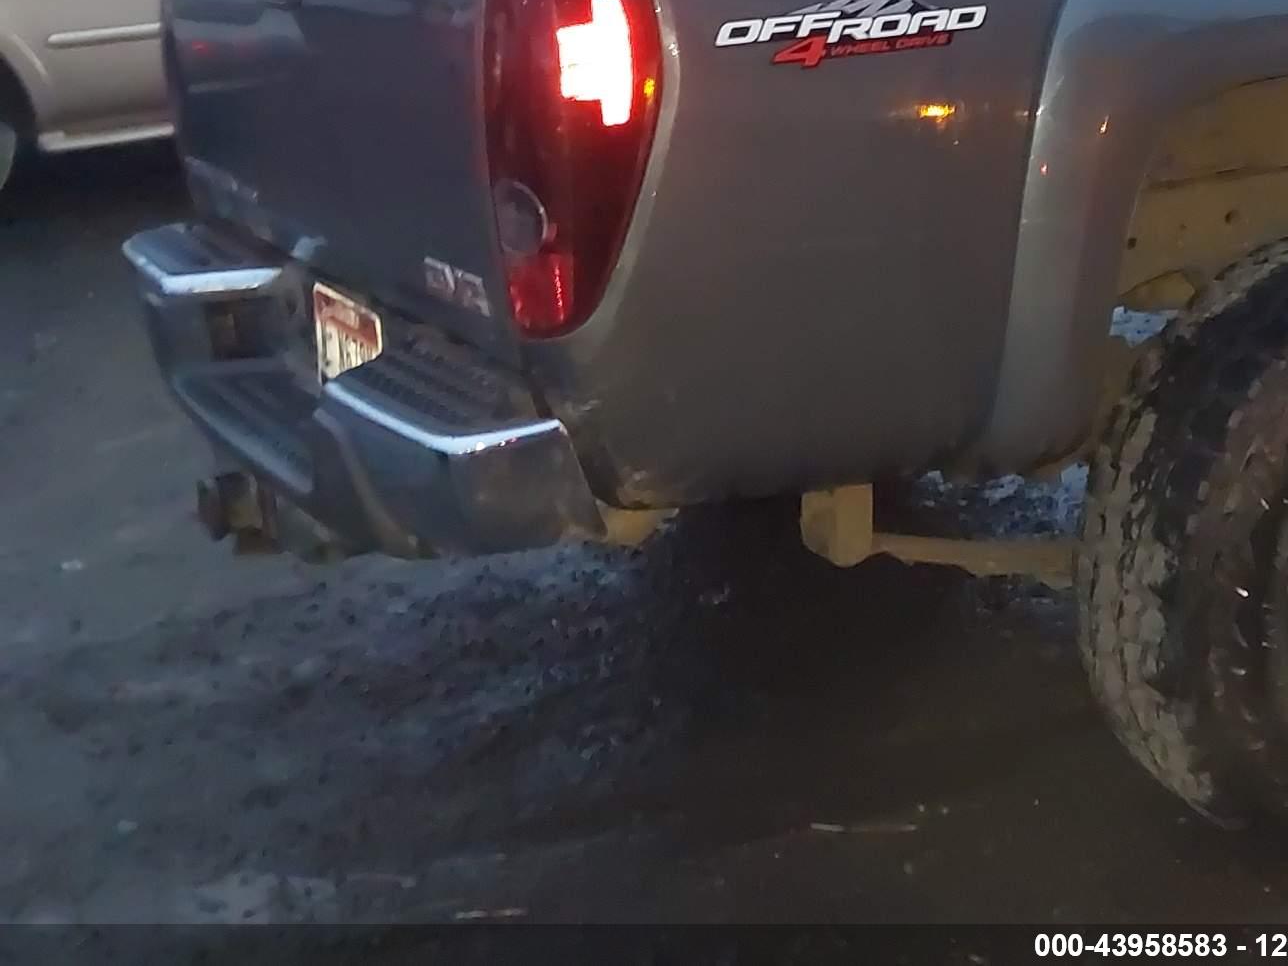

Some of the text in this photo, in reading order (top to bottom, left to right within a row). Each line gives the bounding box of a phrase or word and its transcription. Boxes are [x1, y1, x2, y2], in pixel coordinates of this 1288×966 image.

[714, 5, 987, 46] OFFROAD
[771, 35, 827, 67] 4
[830, 39, 890, 57] WHEEL
